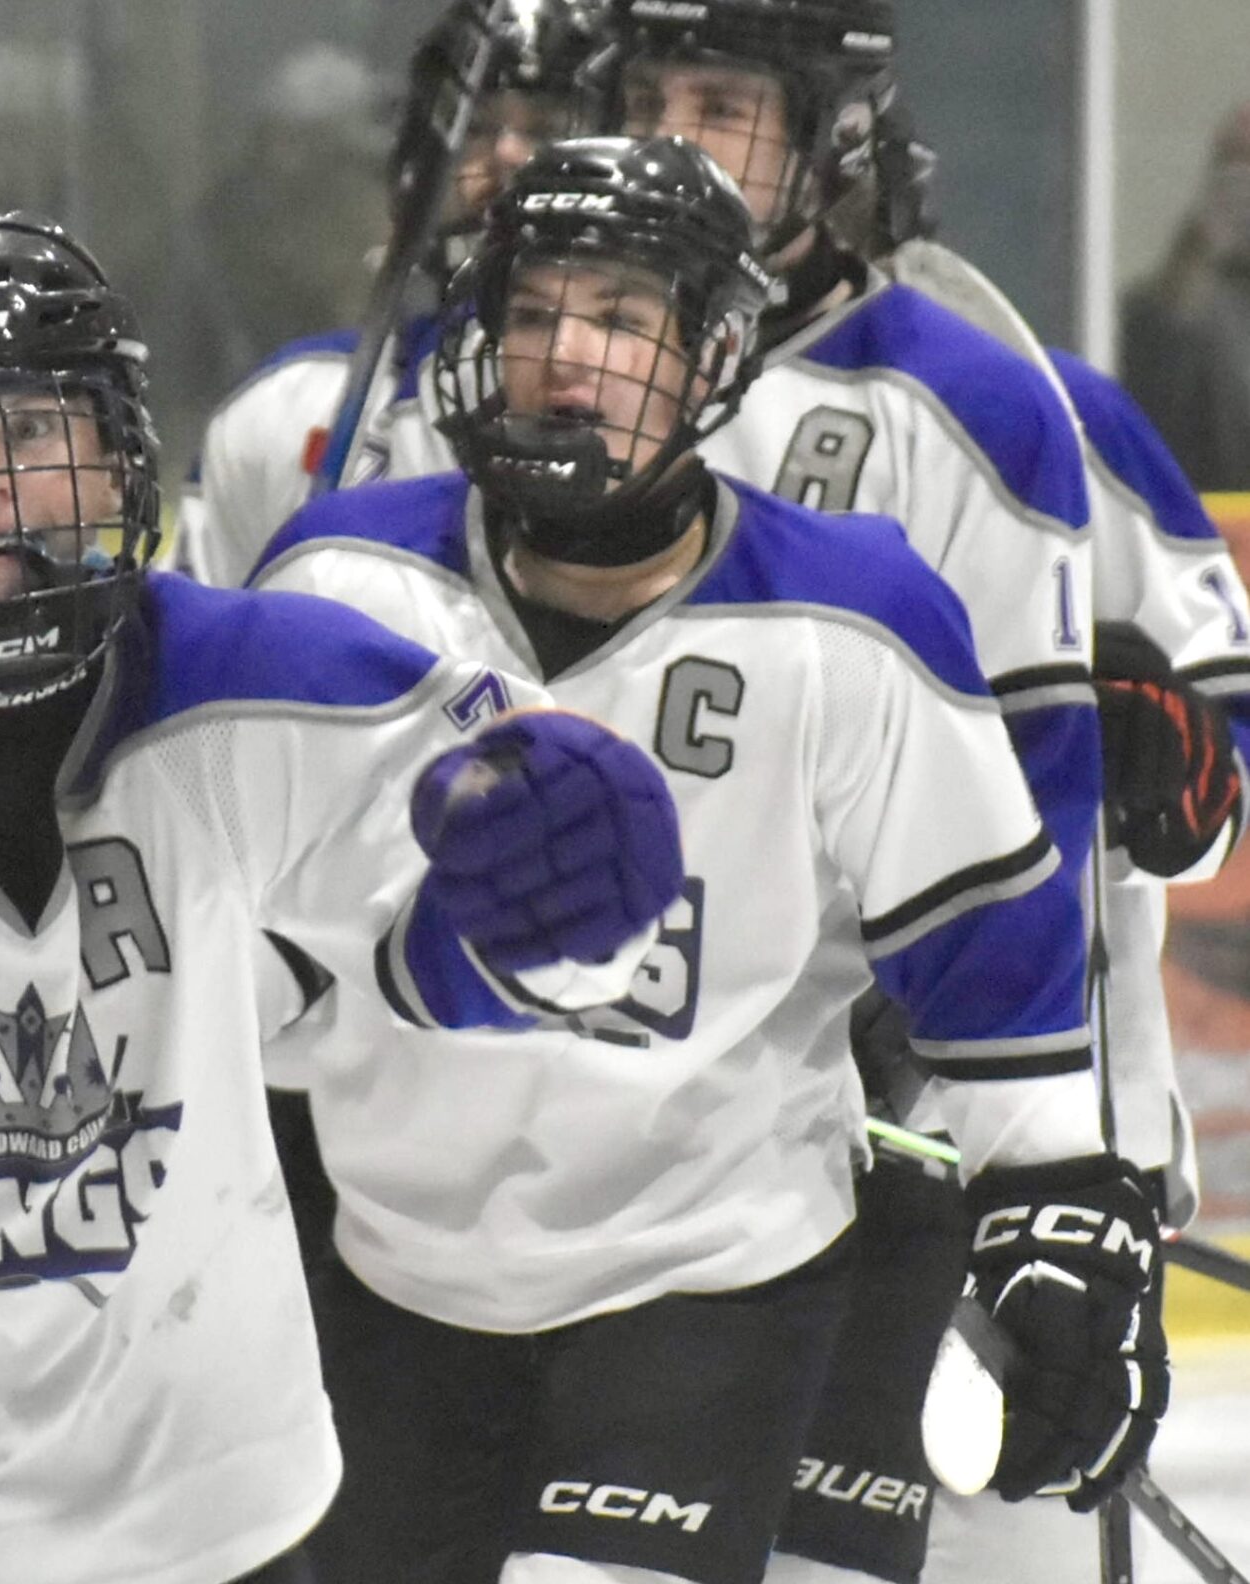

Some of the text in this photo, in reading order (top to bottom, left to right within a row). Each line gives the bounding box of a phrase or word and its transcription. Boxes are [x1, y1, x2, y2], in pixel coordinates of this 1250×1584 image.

[523, 193, 614, 210] CCM
[771, 404, 875, 513] A
[1053, 556, 1082, 651] 1
[654, 654, 745, 780] C
[65, 836, 171, 991] A
[973, 1204, 1153, 1274] CCM
[540, 1481, 712, 1532] CCM
